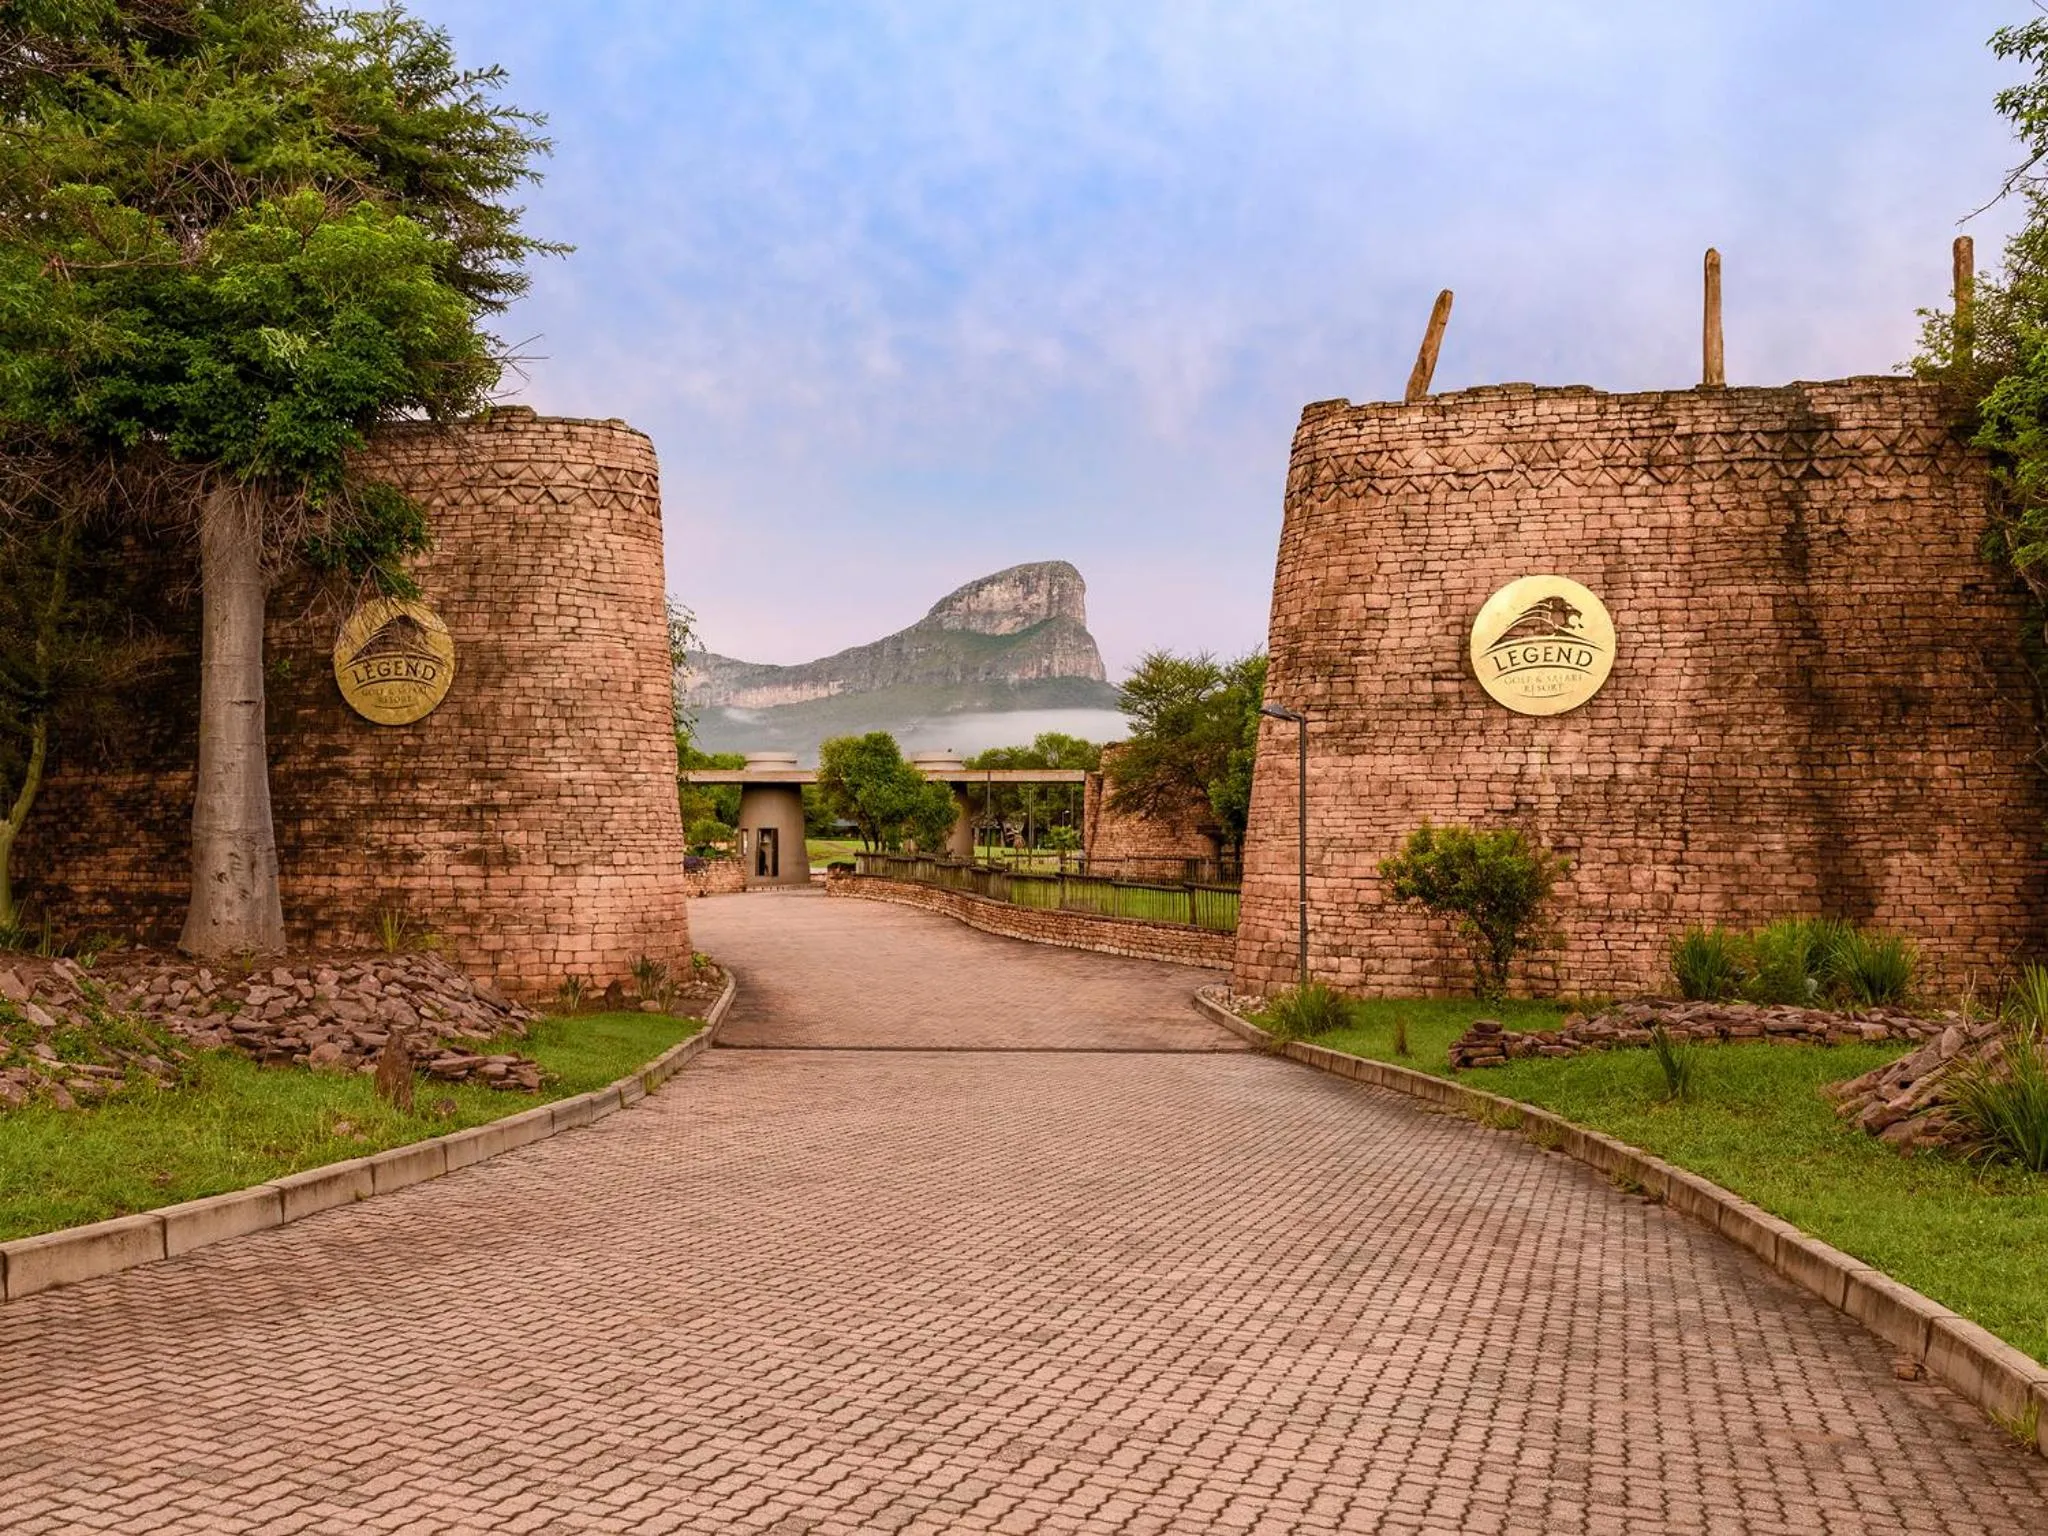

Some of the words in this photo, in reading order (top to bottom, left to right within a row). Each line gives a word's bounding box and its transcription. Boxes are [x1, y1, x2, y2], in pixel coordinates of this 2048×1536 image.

[1493, 646, 1593, 671] LEGEND
[353, 660, 436, 684] LEGEND
[1524, 683, 1564, 692] RESORT
